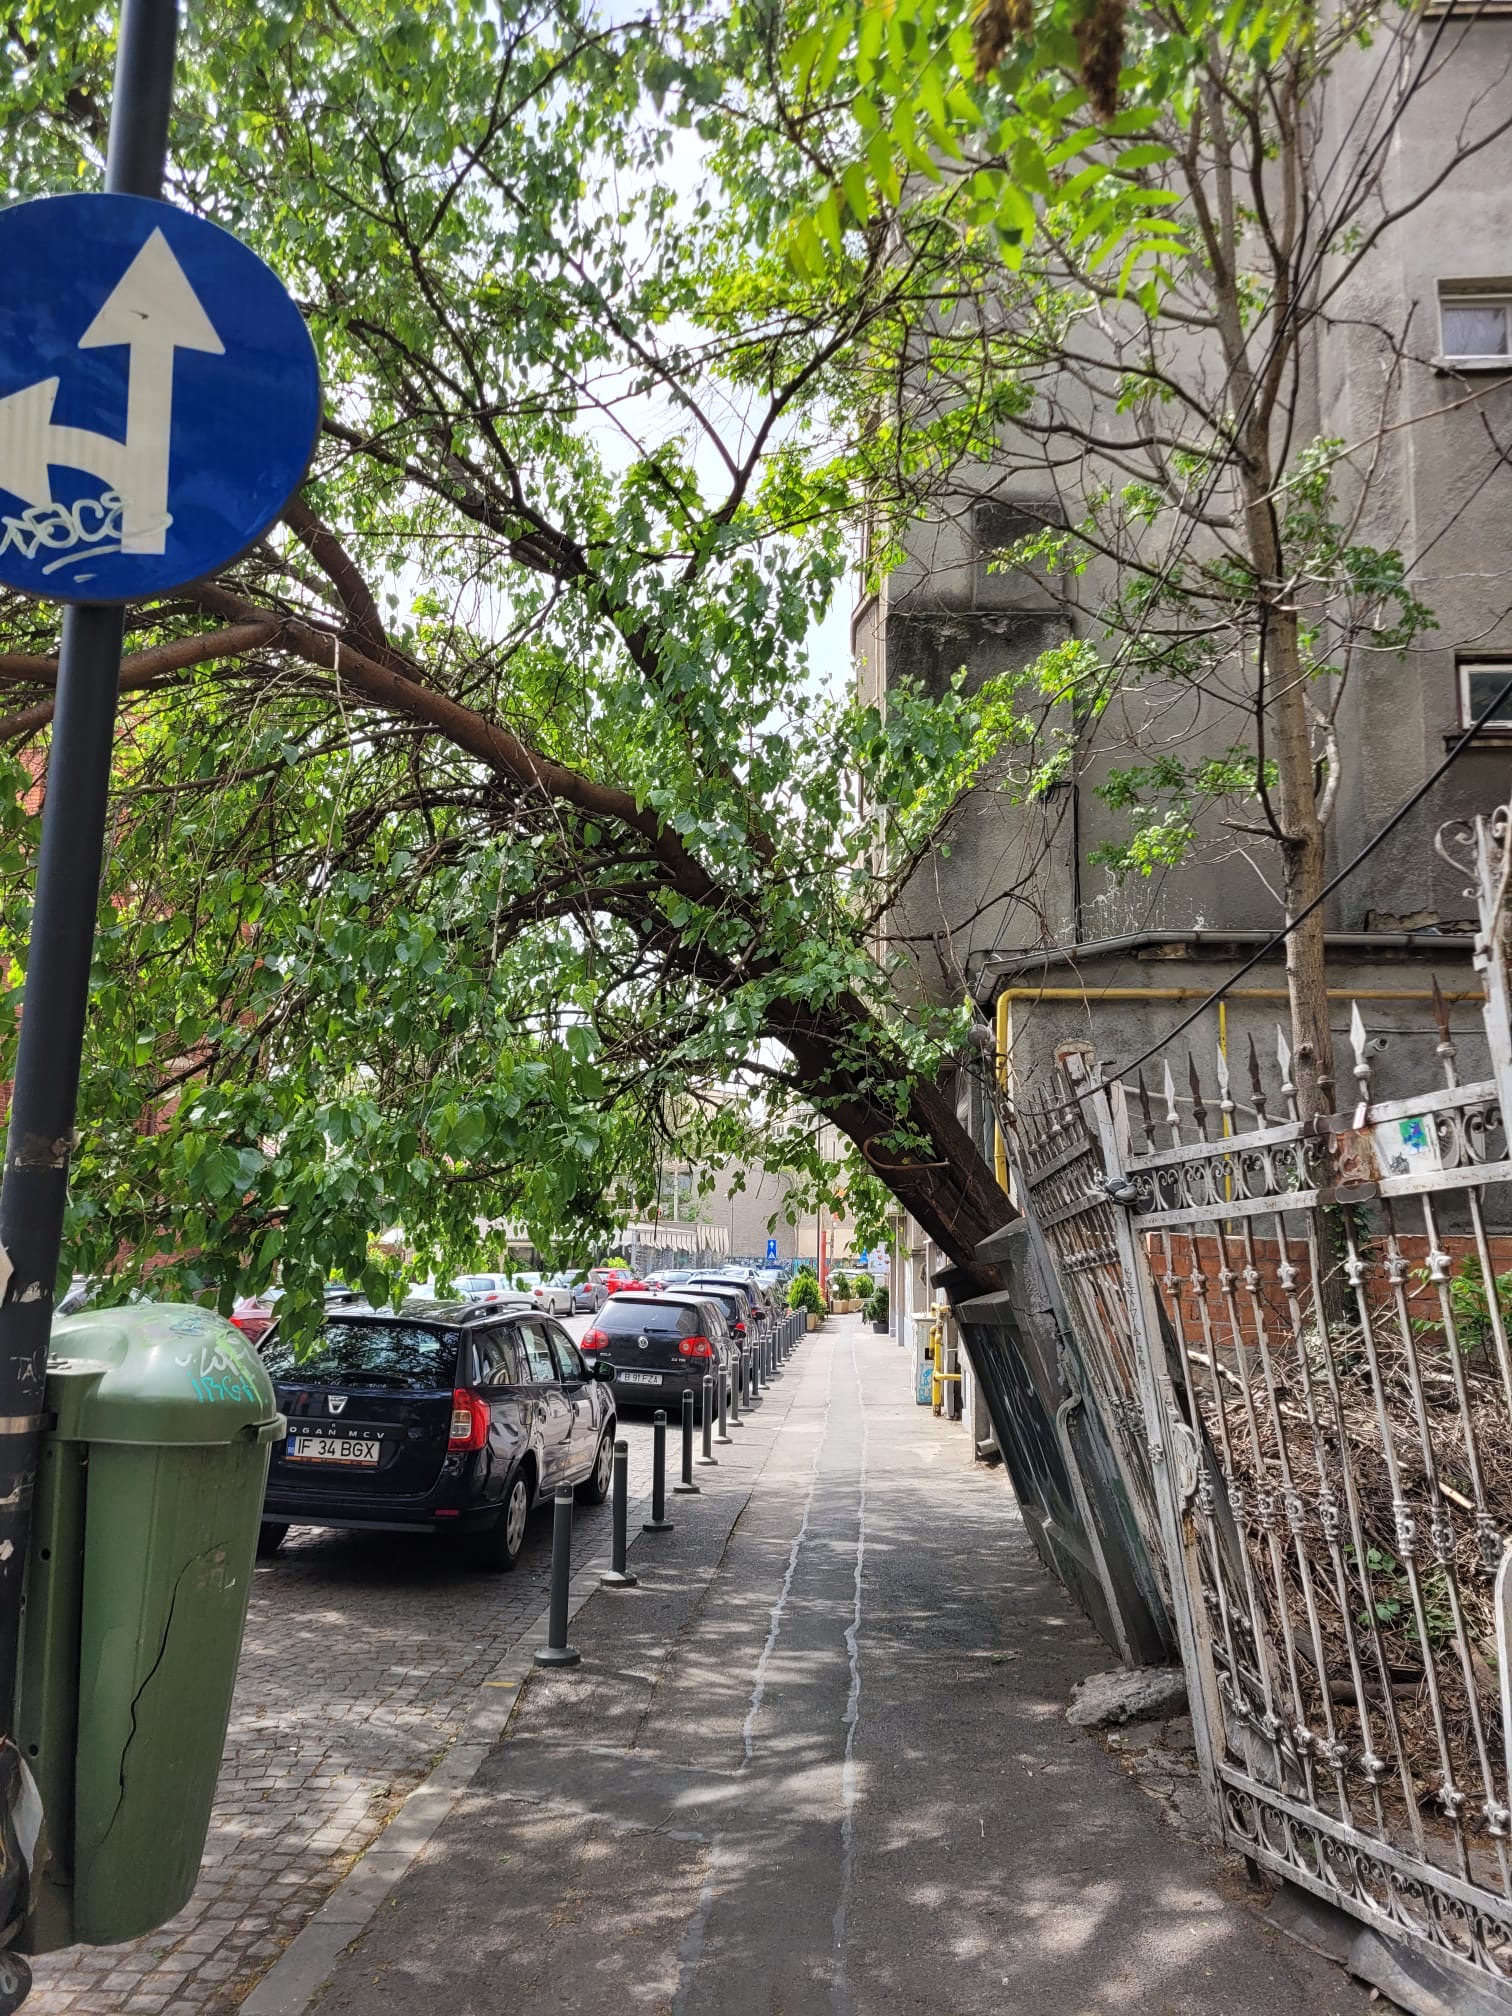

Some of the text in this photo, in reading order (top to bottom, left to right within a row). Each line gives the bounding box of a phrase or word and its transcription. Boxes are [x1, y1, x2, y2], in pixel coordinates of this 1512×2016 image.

[289, 1426, 385, 1439] OGAN MCV
[298, 1438, 313, 1455] IF
[318, 1440, 336, 1456] 34
[340, 1441, 376, 1459] BGX
